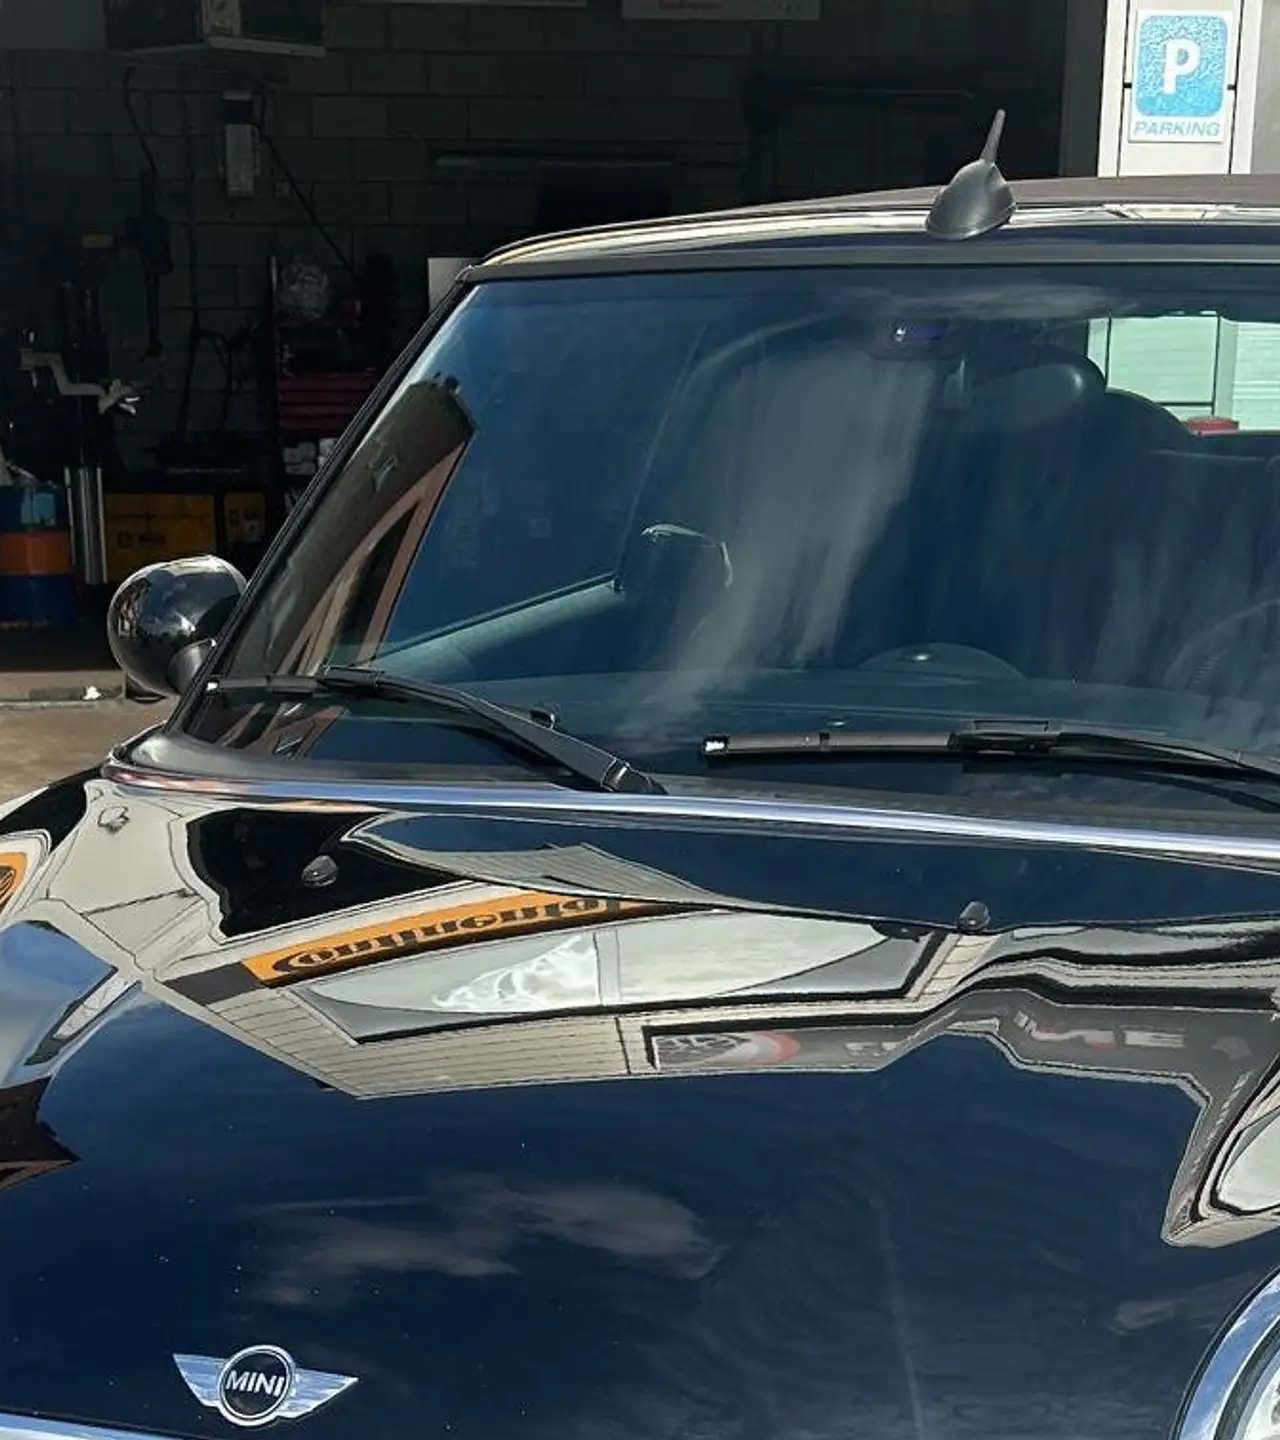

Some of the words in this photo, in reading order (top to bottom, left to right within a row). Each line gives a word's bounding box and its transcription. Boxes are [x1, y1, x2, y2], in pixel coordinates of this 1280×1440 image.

[1163, 39, 1201, 94] P
[1133, 121, 1221, 138] PARKING
[226, 1370, 285, 1398] MINI
